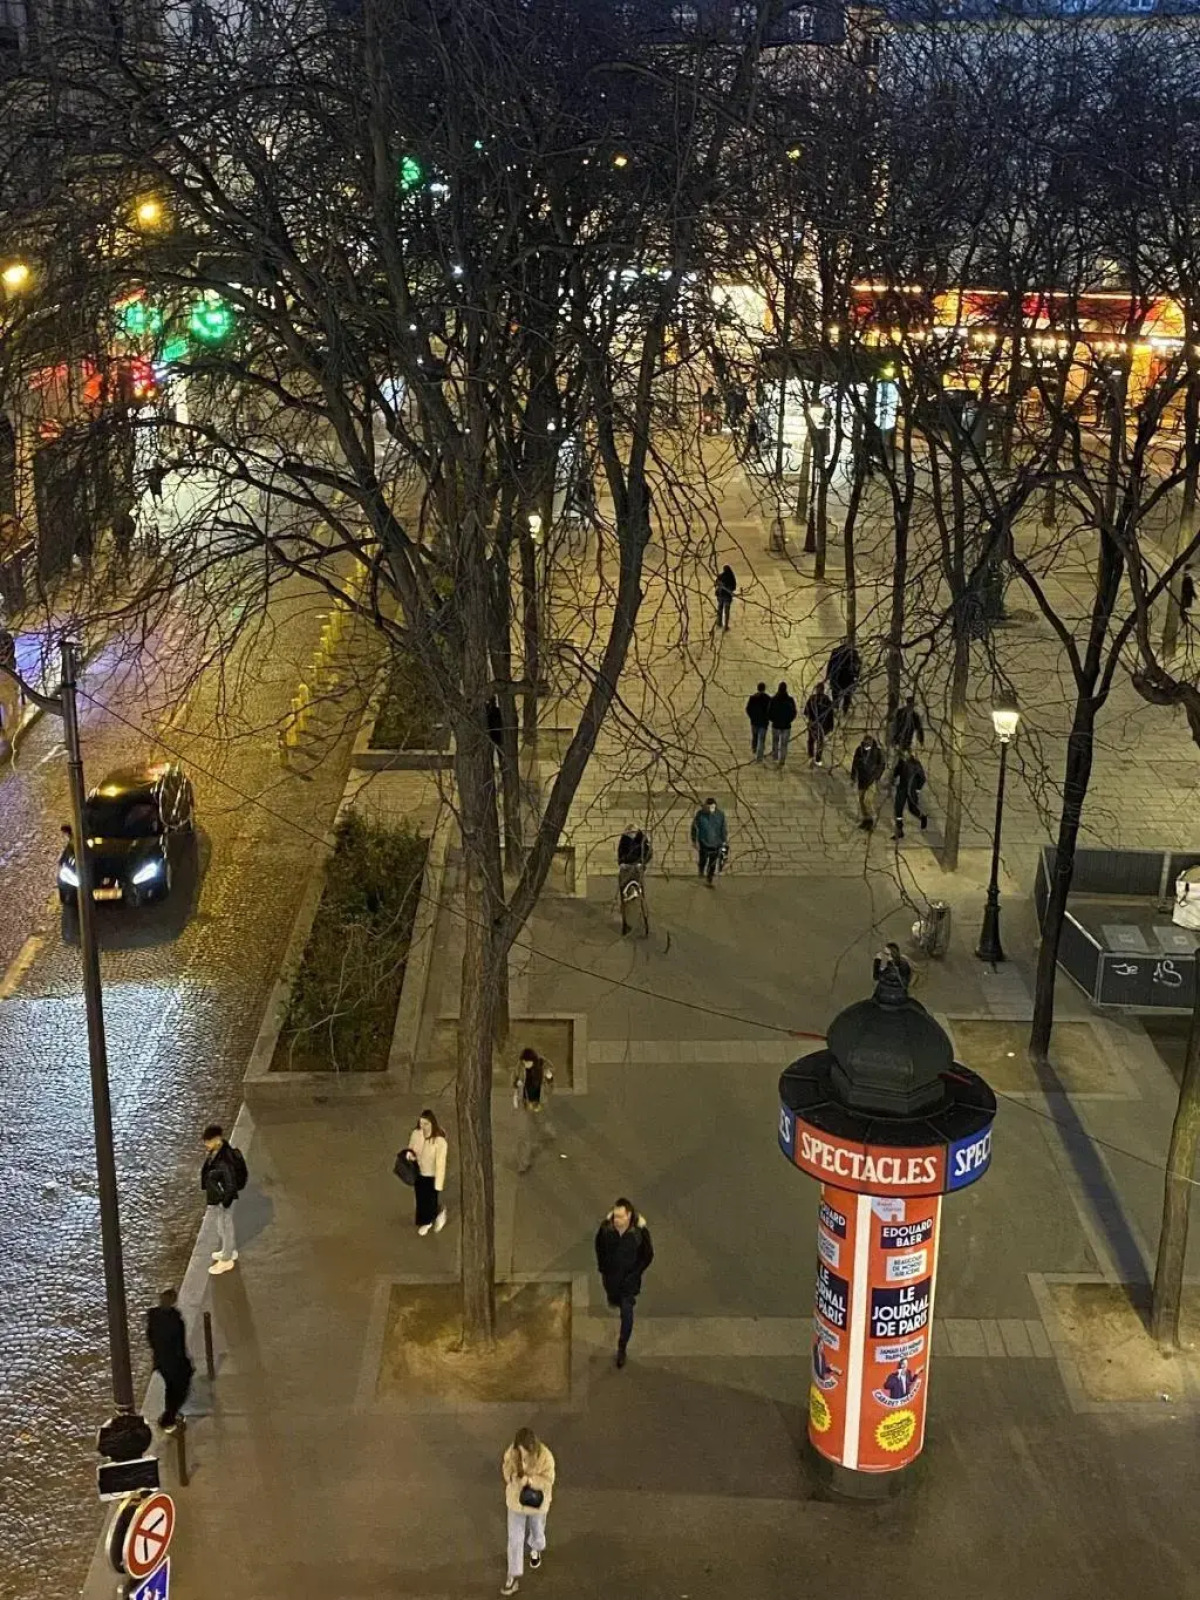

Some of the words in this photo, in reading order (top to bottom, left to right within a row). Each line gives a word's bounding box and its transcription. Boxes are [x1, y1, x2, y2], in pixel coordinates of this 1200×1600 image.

[801, 1131, 938, 1185] SPECTACLES
[882, 1218, 933, 1238] EDOUARD
[895, 1233, 922, 1247] BAER
[820, 1265, 830, 1286] LE
[899, 1286, 915, 1303] LE
[871, 1294, 929, 1321] JOURNAL
[876, 1321, 896, 1337] DE
[898, 1308, 928, 1336] PARIS
